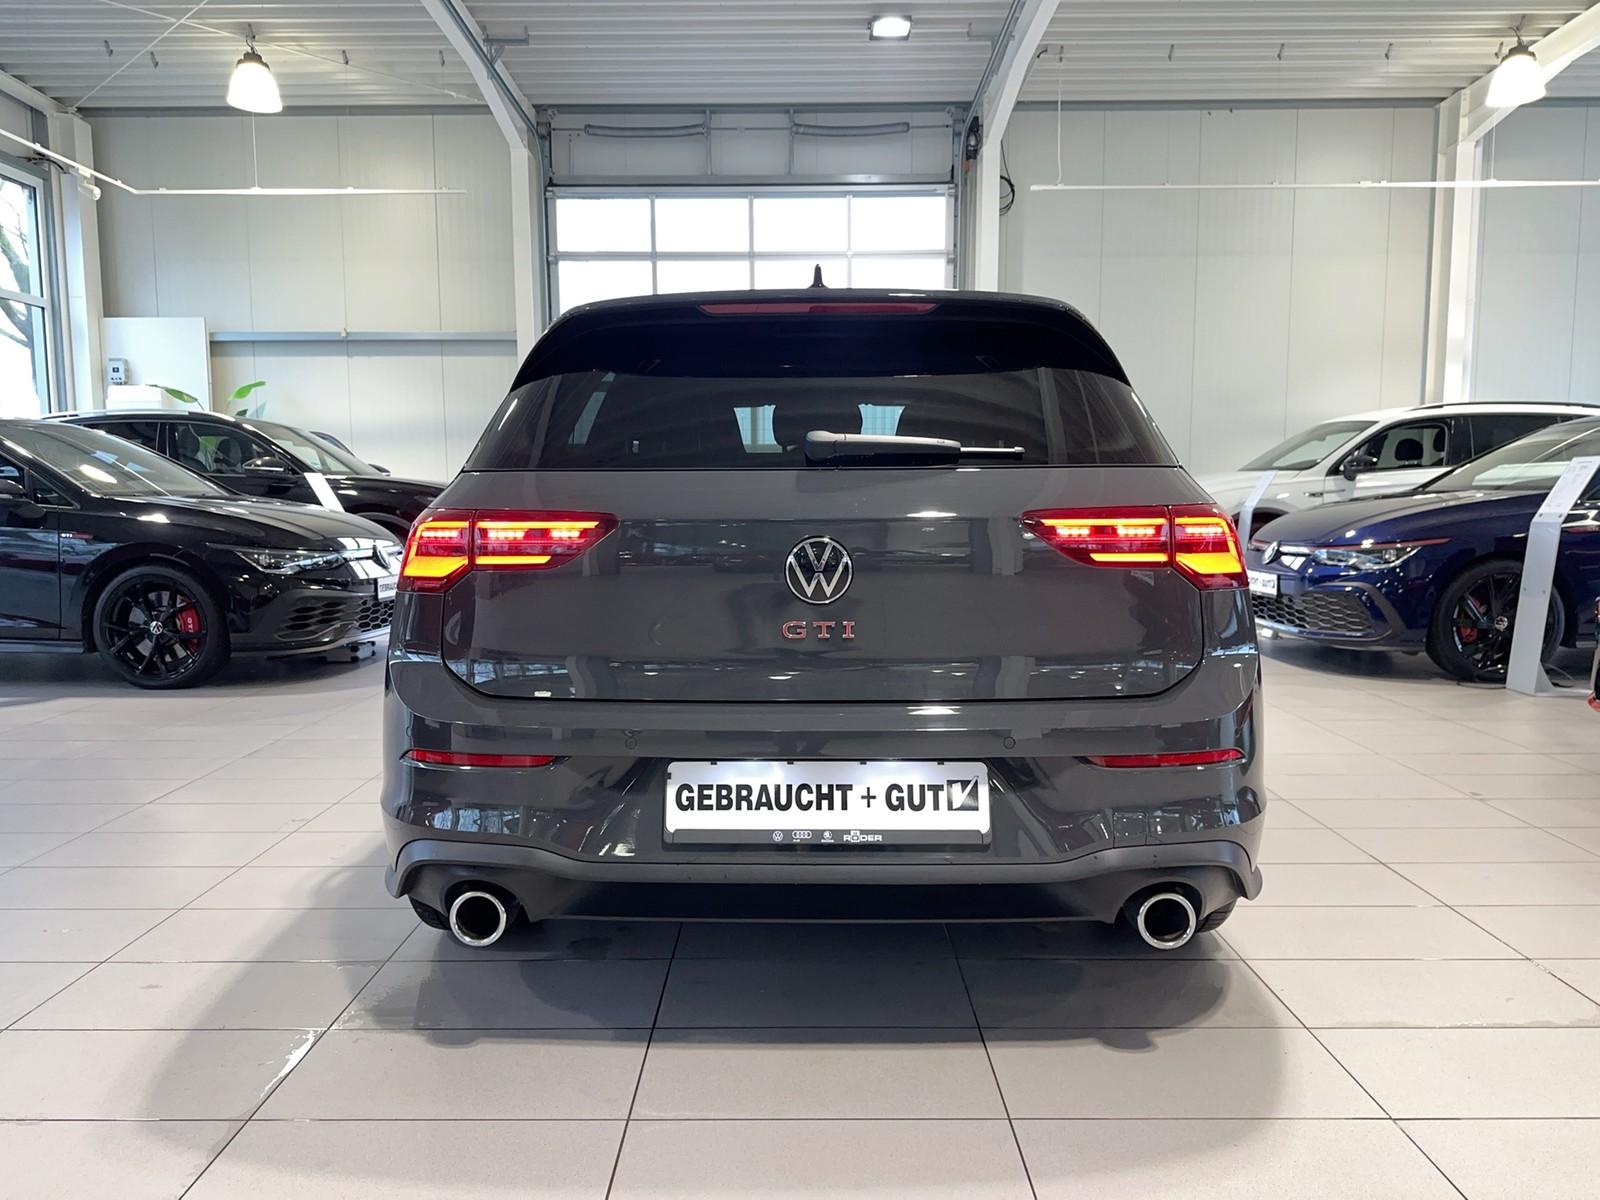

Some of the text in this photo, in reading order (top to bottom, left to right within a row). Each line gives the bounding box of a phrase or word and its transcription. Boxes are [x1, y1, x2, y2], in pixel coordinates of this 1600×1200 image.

[782, 620, 856, 639] GTI
[675, 783, 945, 811] GEBRAUCHT + GUT
